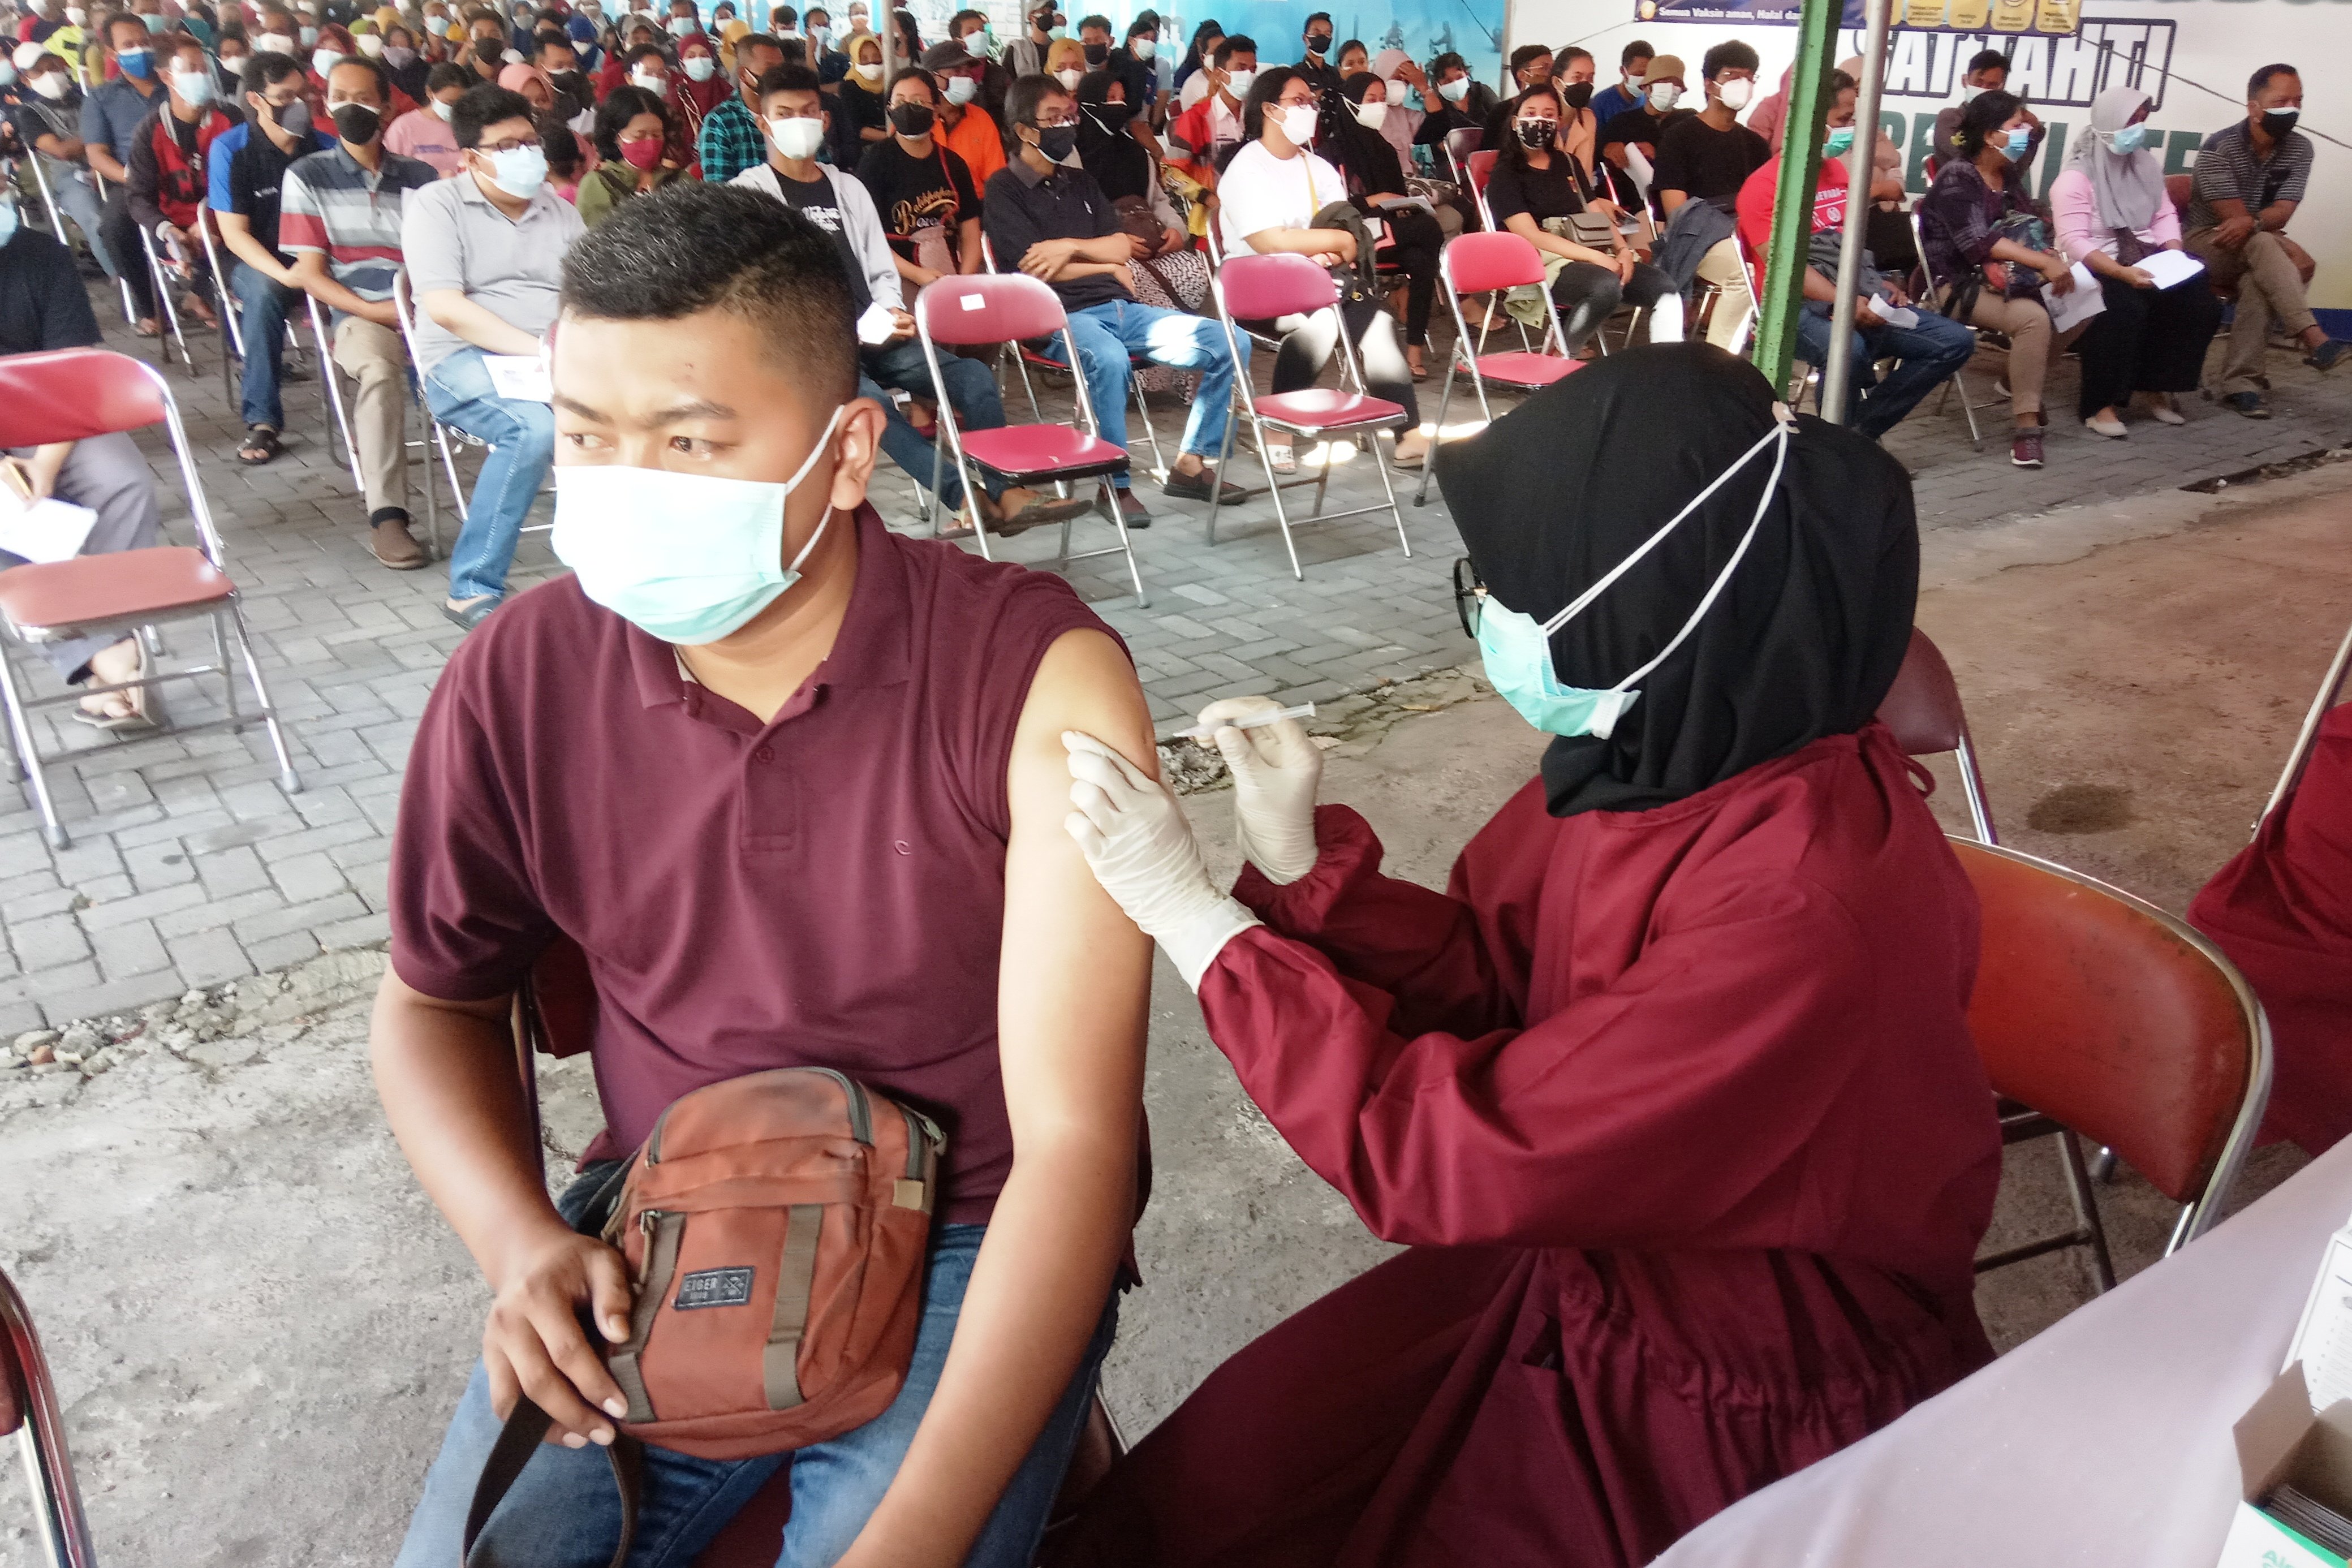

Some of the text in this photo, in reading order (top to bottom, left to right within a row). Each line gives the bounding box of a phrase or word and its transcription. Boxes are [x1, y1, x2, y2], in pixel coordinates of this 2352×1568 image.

[1691, 7, 1725, 18] Vaksin
[1756, 9, 1783, 19] Halal
[683, 1277, 718, 1291] EIGER
